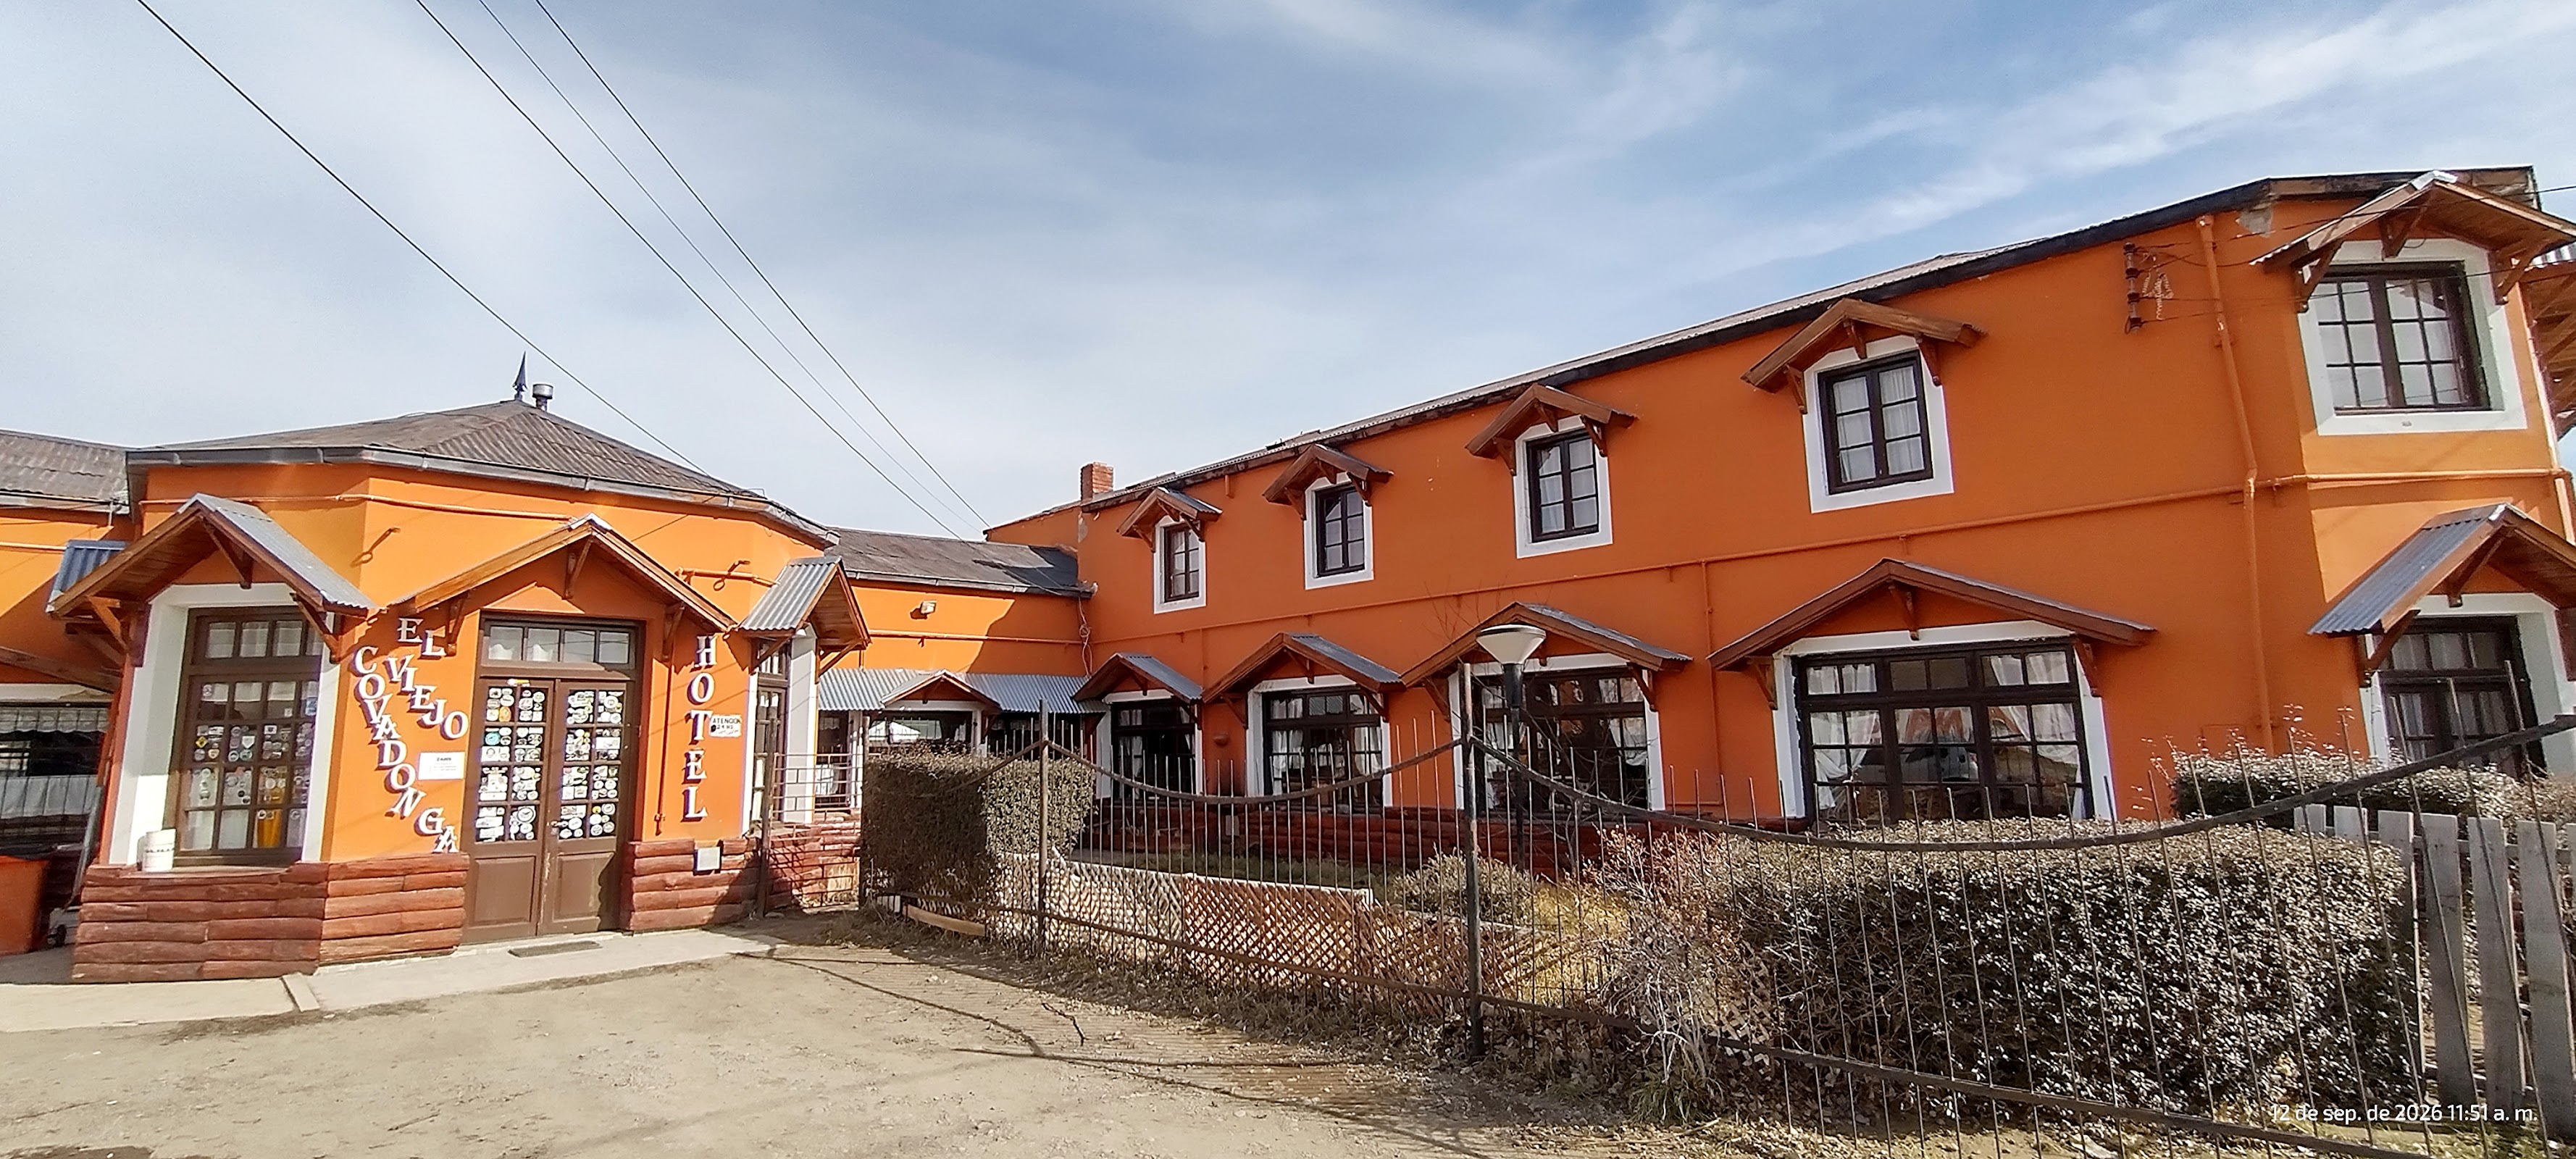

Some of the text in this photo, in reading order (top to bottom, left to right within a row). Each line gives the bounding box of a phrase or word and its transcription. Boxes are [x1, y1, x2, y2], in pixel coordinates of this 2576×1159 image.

[397, 618, 446, 656] EL
[388, 654, 469, 740] VIEJO
[685, 635, 718, 818] HOTEL
